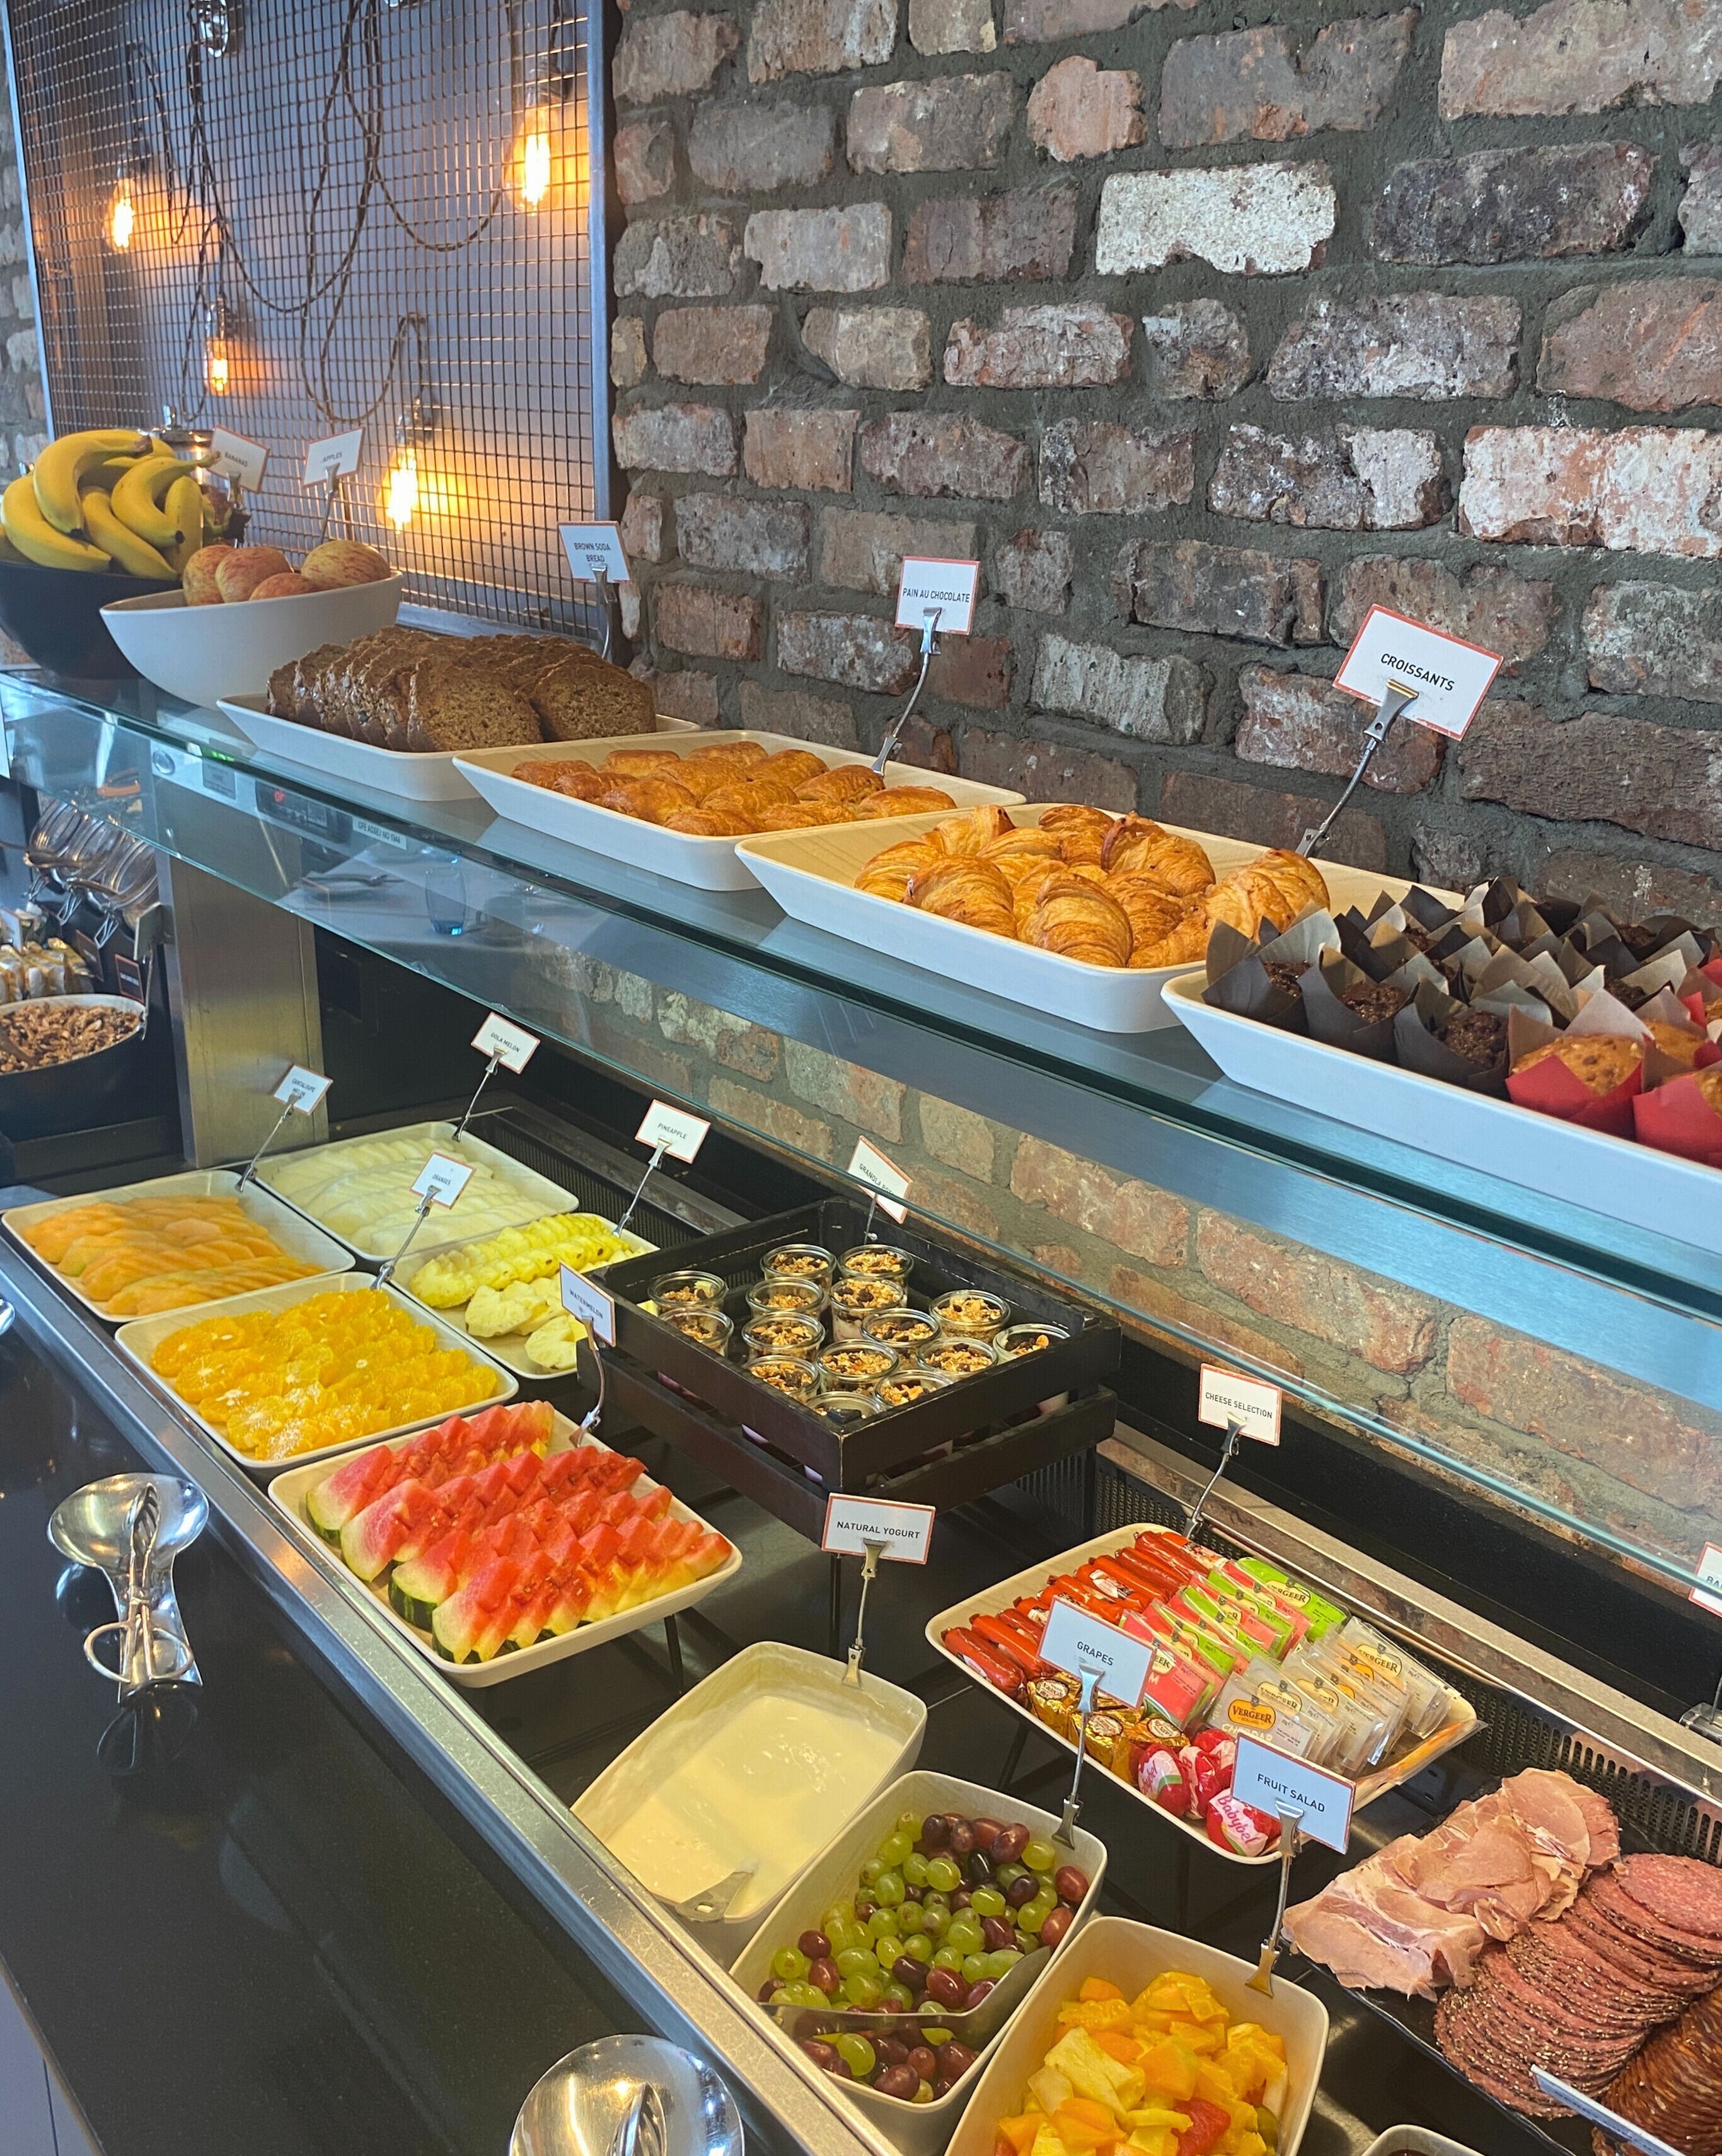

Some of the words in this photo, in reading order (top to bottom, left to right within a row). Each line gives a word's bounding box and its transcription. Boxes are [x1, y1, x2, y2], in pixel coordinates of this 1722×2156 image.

[224, 452, 248, 467] BANANAS
[323, 451, 342, 463] APPLES
[903, 588, 918, 597] PAIN
[920, 590, 929, 598] AU
[930, 591, 970, 602] CHOCOLATE
[1380, 653, 1455, 691] CROISSANTS
[503, 1039, 520, 1052] MELON
[657, 1122, 688, 1139] PINEAPPLE
[432, 1173, 451, 1186] ORANGES
[859, 1163, 881, 1185] GRANOLA
[569, 1288, 603, 1319] WATERMELON
[1205, 1392, 1232, 1407] CHEESE
[1234, 1400, 1273, 1419] SELECTION
[836, 1521, 881, 1534] NATURAL
[883, 1527, 921, 1539] YOGURT
[1706, 1576, 1722, 1588] RA
[1077, 1641, 1114, 1666] GRAPES
[1358, 1648, 1398, 1674] RGEER
[1232, 1705, 1272, 1724] VERGEER
[1257, 1773, 1288, 1795] FRUIT
[1290, 1789, 1325, 1812] SALAD
[1217, 1796, 1261, 1844] Babybel
